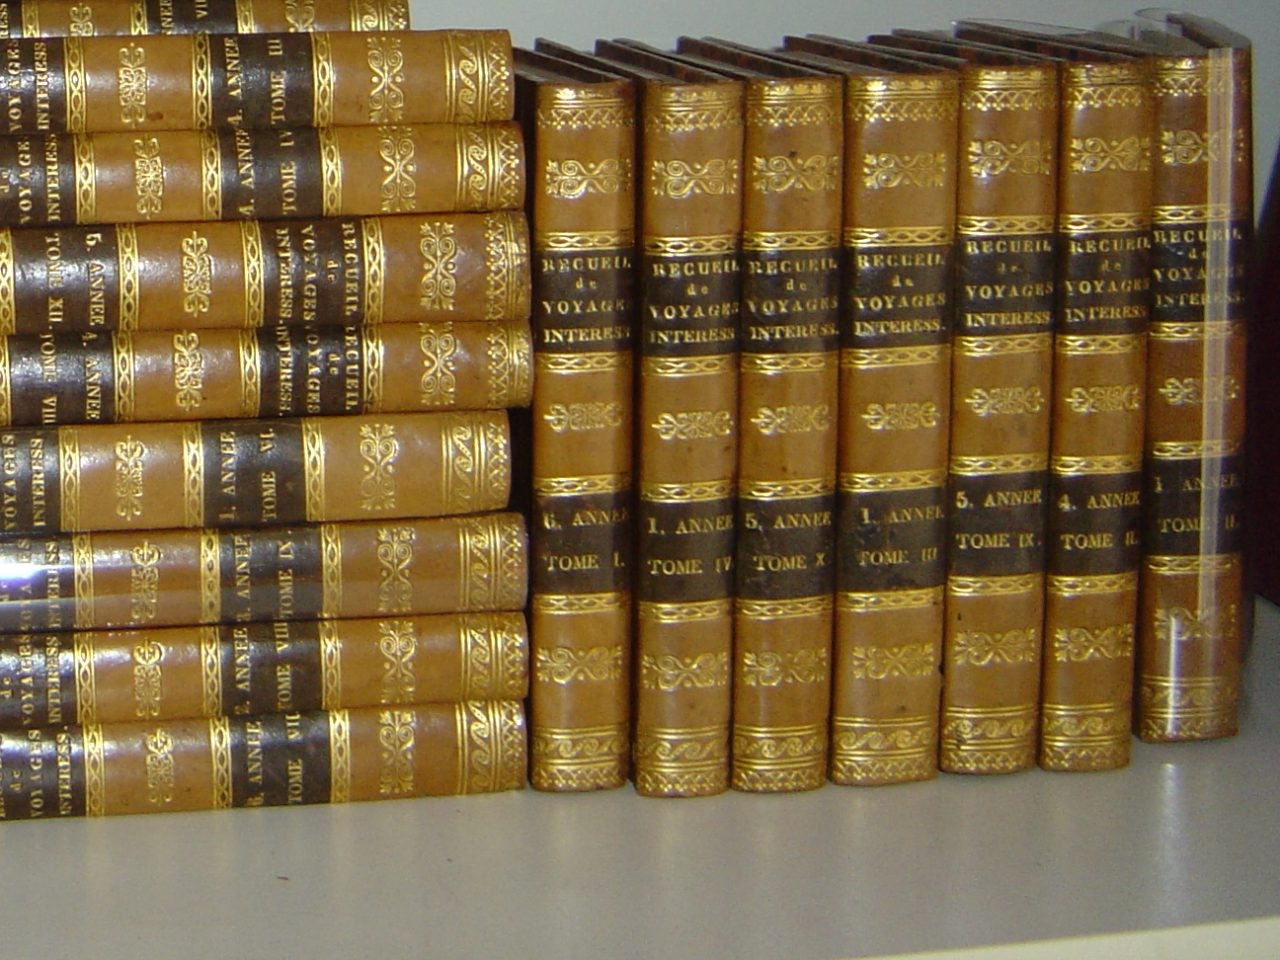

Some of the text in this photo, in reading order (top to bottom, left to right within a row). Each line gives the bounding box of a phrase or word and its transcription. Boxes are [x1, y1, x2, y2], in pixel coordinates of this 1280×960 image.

[224, 37, 242, 99] ANNEE
[7, 40, 22, 130] VOYAGES
[270, 70, 287, 124] TOME
[280, 161, 297, 214] TOME
[965, 239, 1051, 255] RECUEIL
[1070, 237, 1151, 254] RECUEIL
[327, 260, 338, 281] de
[341, 223, 358, 315] RECUEIL
[542, 256, 630, 273] RECUEIL
[652, 260, 739, 278] RECUEIL
[748, 258, 837, 275] RECUEIL
[857, 253, 944, 270] RECUEIL
[45, 233, 63, 330] TOME XII.
[276, 228, 293, 324] INTERESS.
[300, 225, 317, 320] VOYAGES
[576, 276, 597, 290] de
[687, 283, 709, 296] de
[786, 279, 807, 292] de
[965, 282, 1054, 300] VOYAGES
[1065, 278, 1151, 296] VOYAGES
[88, 262, 105, 326] ANNEE
[855, 292, 945, 311] VOYAGES
[649, 302, 739, 320] VOYAGES
[747, 297, 837, 316] VOYAGES
[749, 323, 839, 341] INTERESS.
[853, 319, 946, 337] INTERESS.
[328, 353, 340, 374] de
[85, 358, 100, 420] ANNEE
[220, 431, 236, 496] ANNEE
[1, 434, 17, 529] VOYAGES
[261, 471, 277, 521] TOME
[955, 489, 1041, 509] 5. ANNEE
[1059, 491, 1140, 511] 4. ANNEE
[648, 514, 734, 535] 1. ANNEE
[773, 511, 831, 529] ANNEE
[885, 506, 944, 524] ANNEE
[955, 533, 1010, 550] TOME
[1060, 534, 1113, 551] TOME
[234, 535, 251, 598] ANNEE
[544, 553, 598, 571] TOME
[647, 559, 702, 575] TOME
[752, 555, 807, 572] TOME
[856, 550, 909, 567] TOME
[278, 569, 294, 618] TOME
[233, 628, 250, 692] ANNEE
[19, 635, 34, 724] VOYAGES
[246, 721, 263, 784] ANNEE
